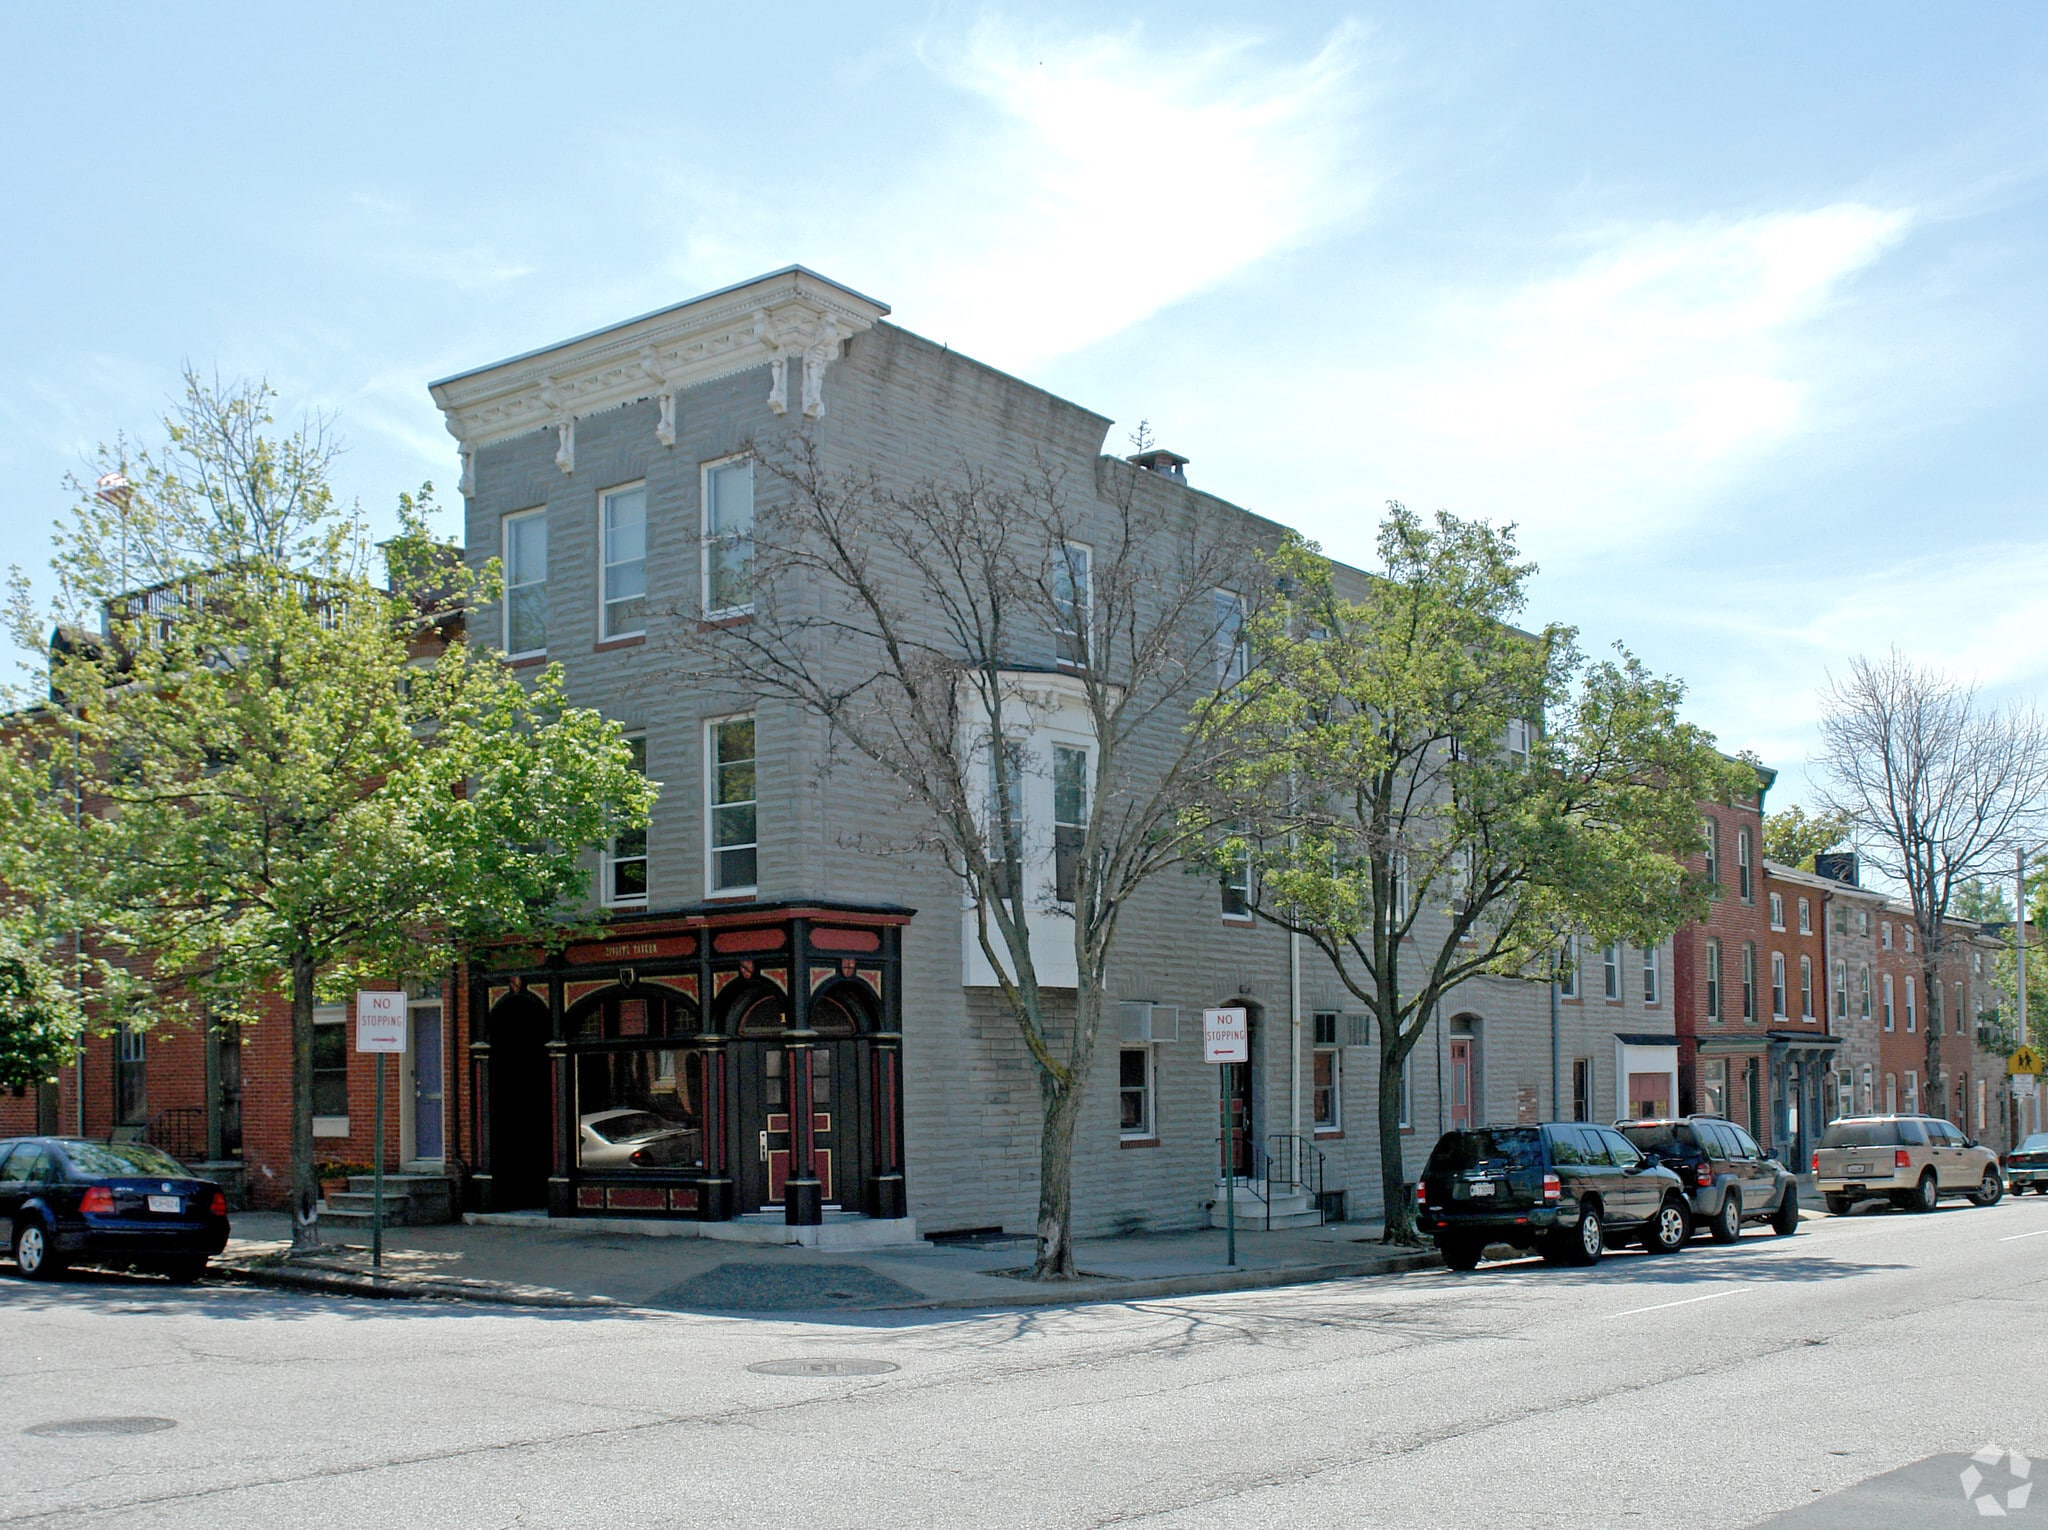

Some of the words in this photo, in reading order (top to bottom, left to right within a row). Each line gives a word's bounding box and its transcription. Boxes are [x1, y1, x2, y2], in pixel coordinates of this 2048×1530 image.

[373, 998, 391, 1009] NO
[361, 1015, 402, 1027] STOPPING
[1217, 1014, 1233, 1025] NO
[1207, 1030, 1245, 1042] STOPPING
